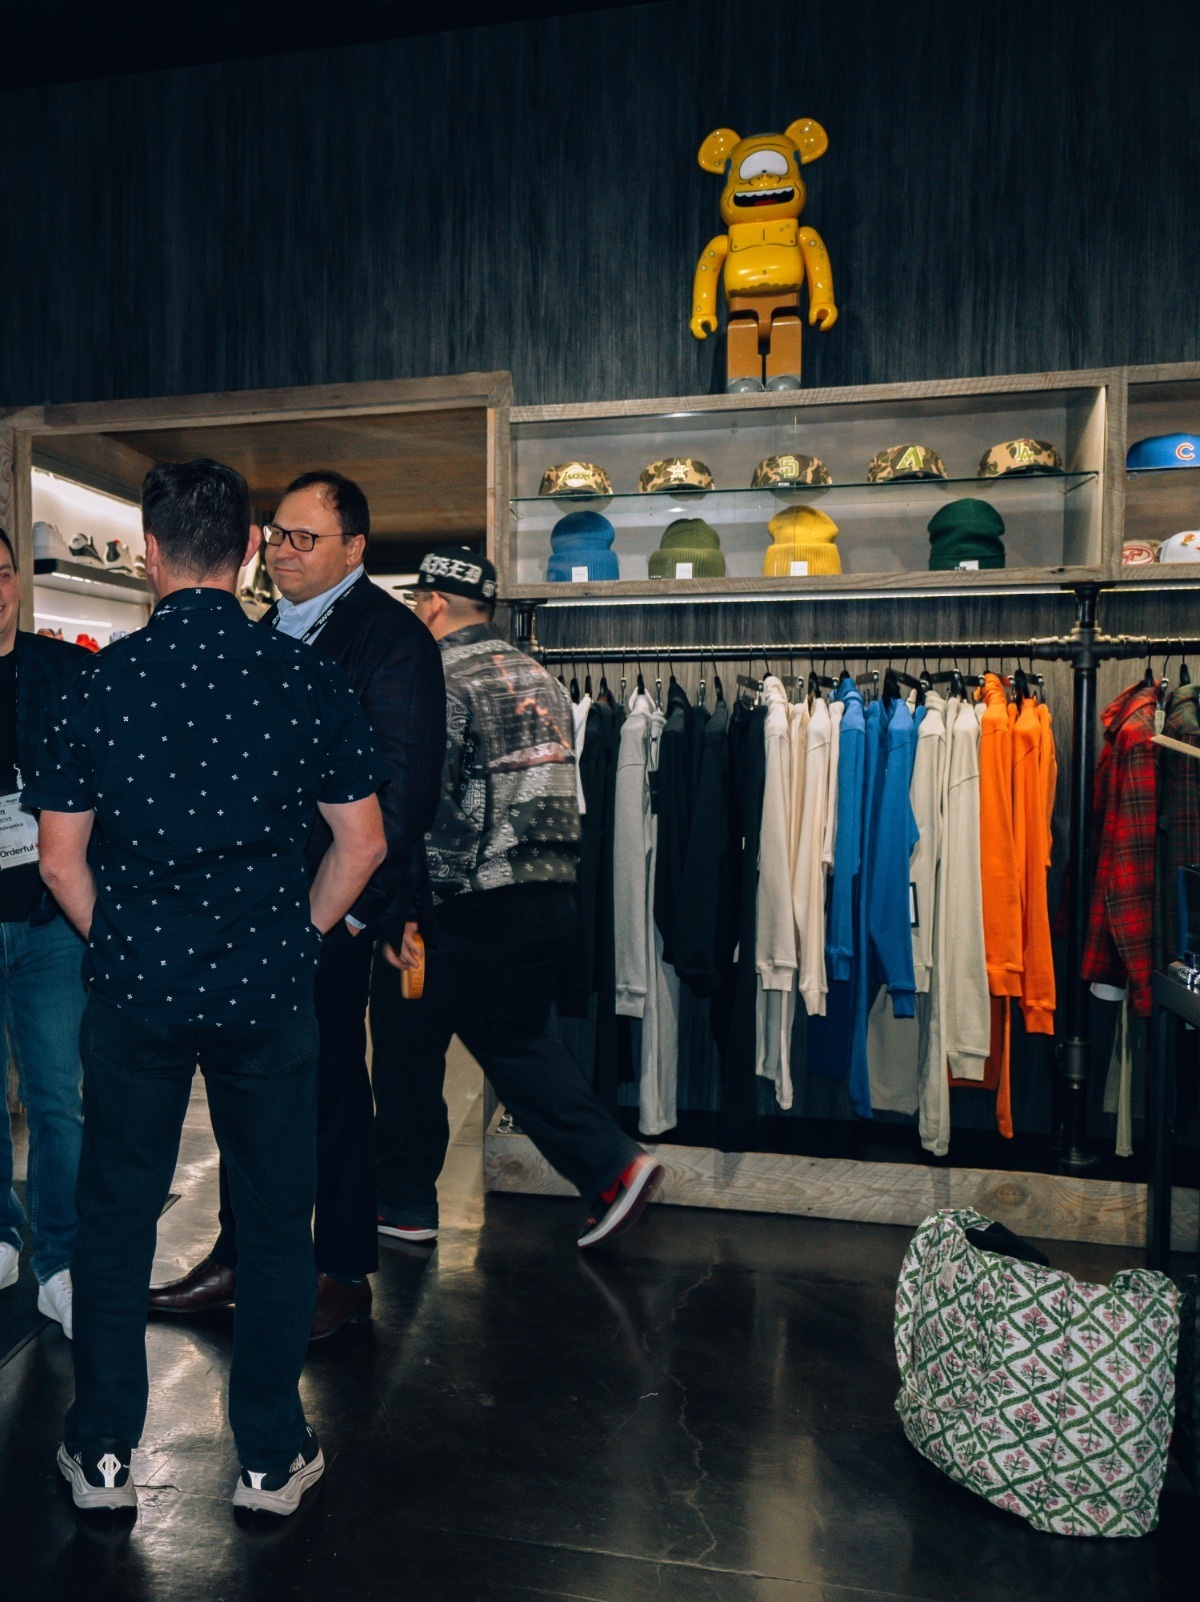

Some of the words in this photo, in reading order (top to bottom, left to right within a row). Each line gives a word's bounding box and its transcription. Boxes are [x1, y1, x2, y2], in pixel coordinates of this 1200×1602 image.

[896, 446, 923, 469] A
[1015, 443, 1034, 463] LA
[1176, 443, 1195, 460] C
[0, 843, 35, 858] Orderful
